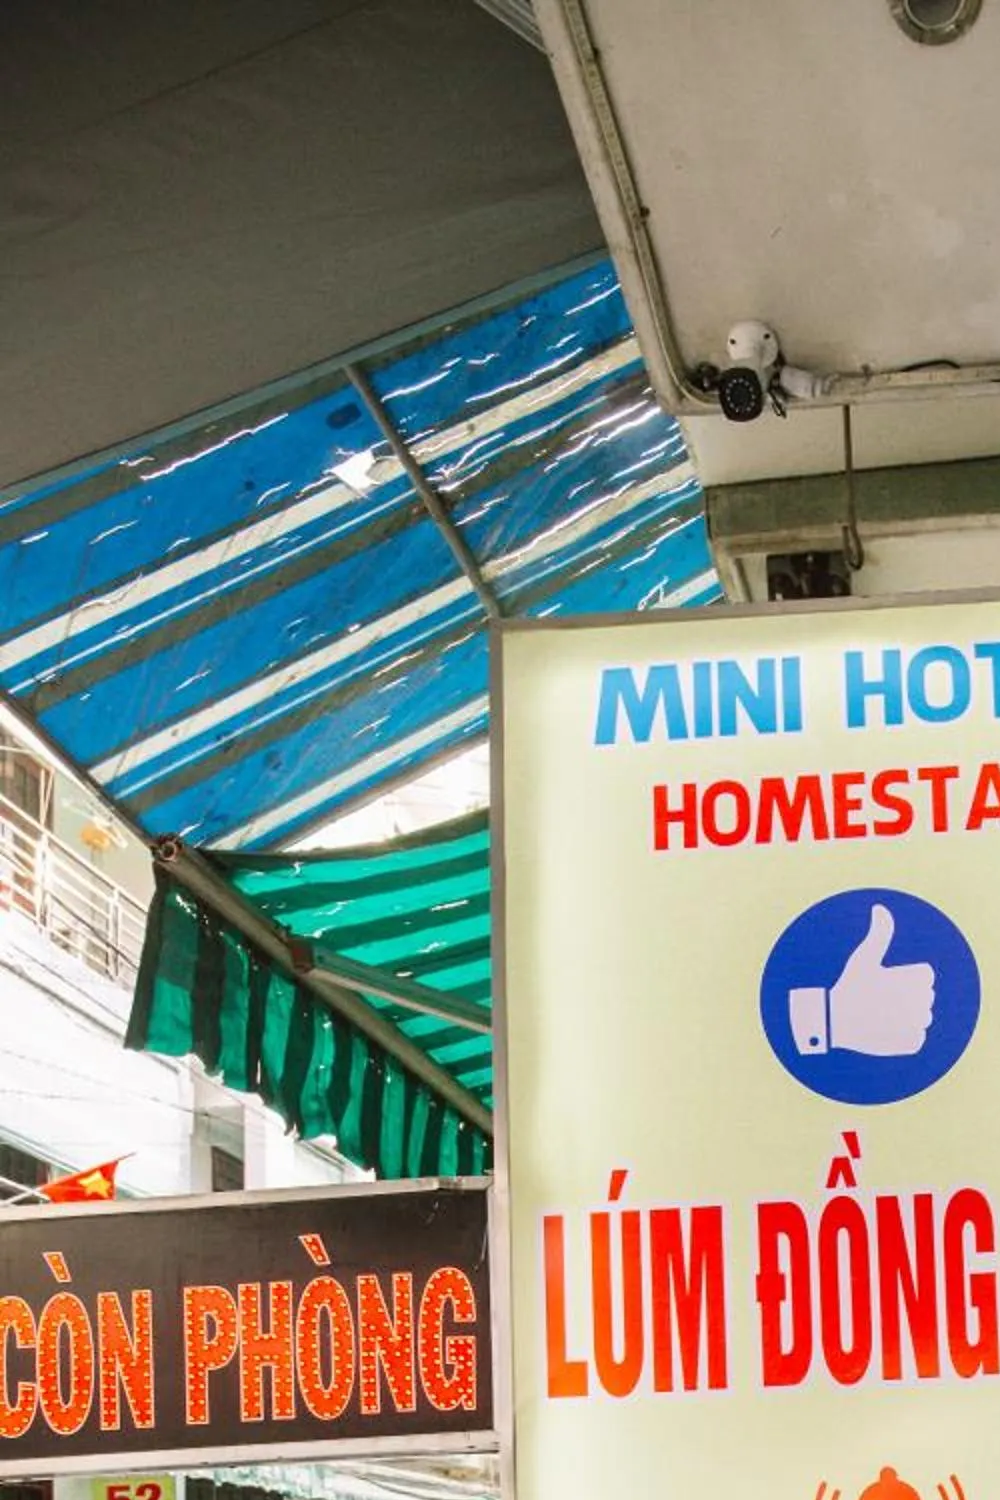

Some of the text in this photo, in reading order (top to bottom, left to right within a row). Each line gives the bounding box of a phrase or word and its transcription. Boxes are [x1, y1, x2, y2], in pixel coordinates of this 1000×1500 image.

[594, 655, 802, 745] MINI
[0, 1233, 478, 1439] CÒN PHÒNG
[543, 1169, 728, 1398] LÚM
[756, 1131, 1000, 1387] ĐỒNG
